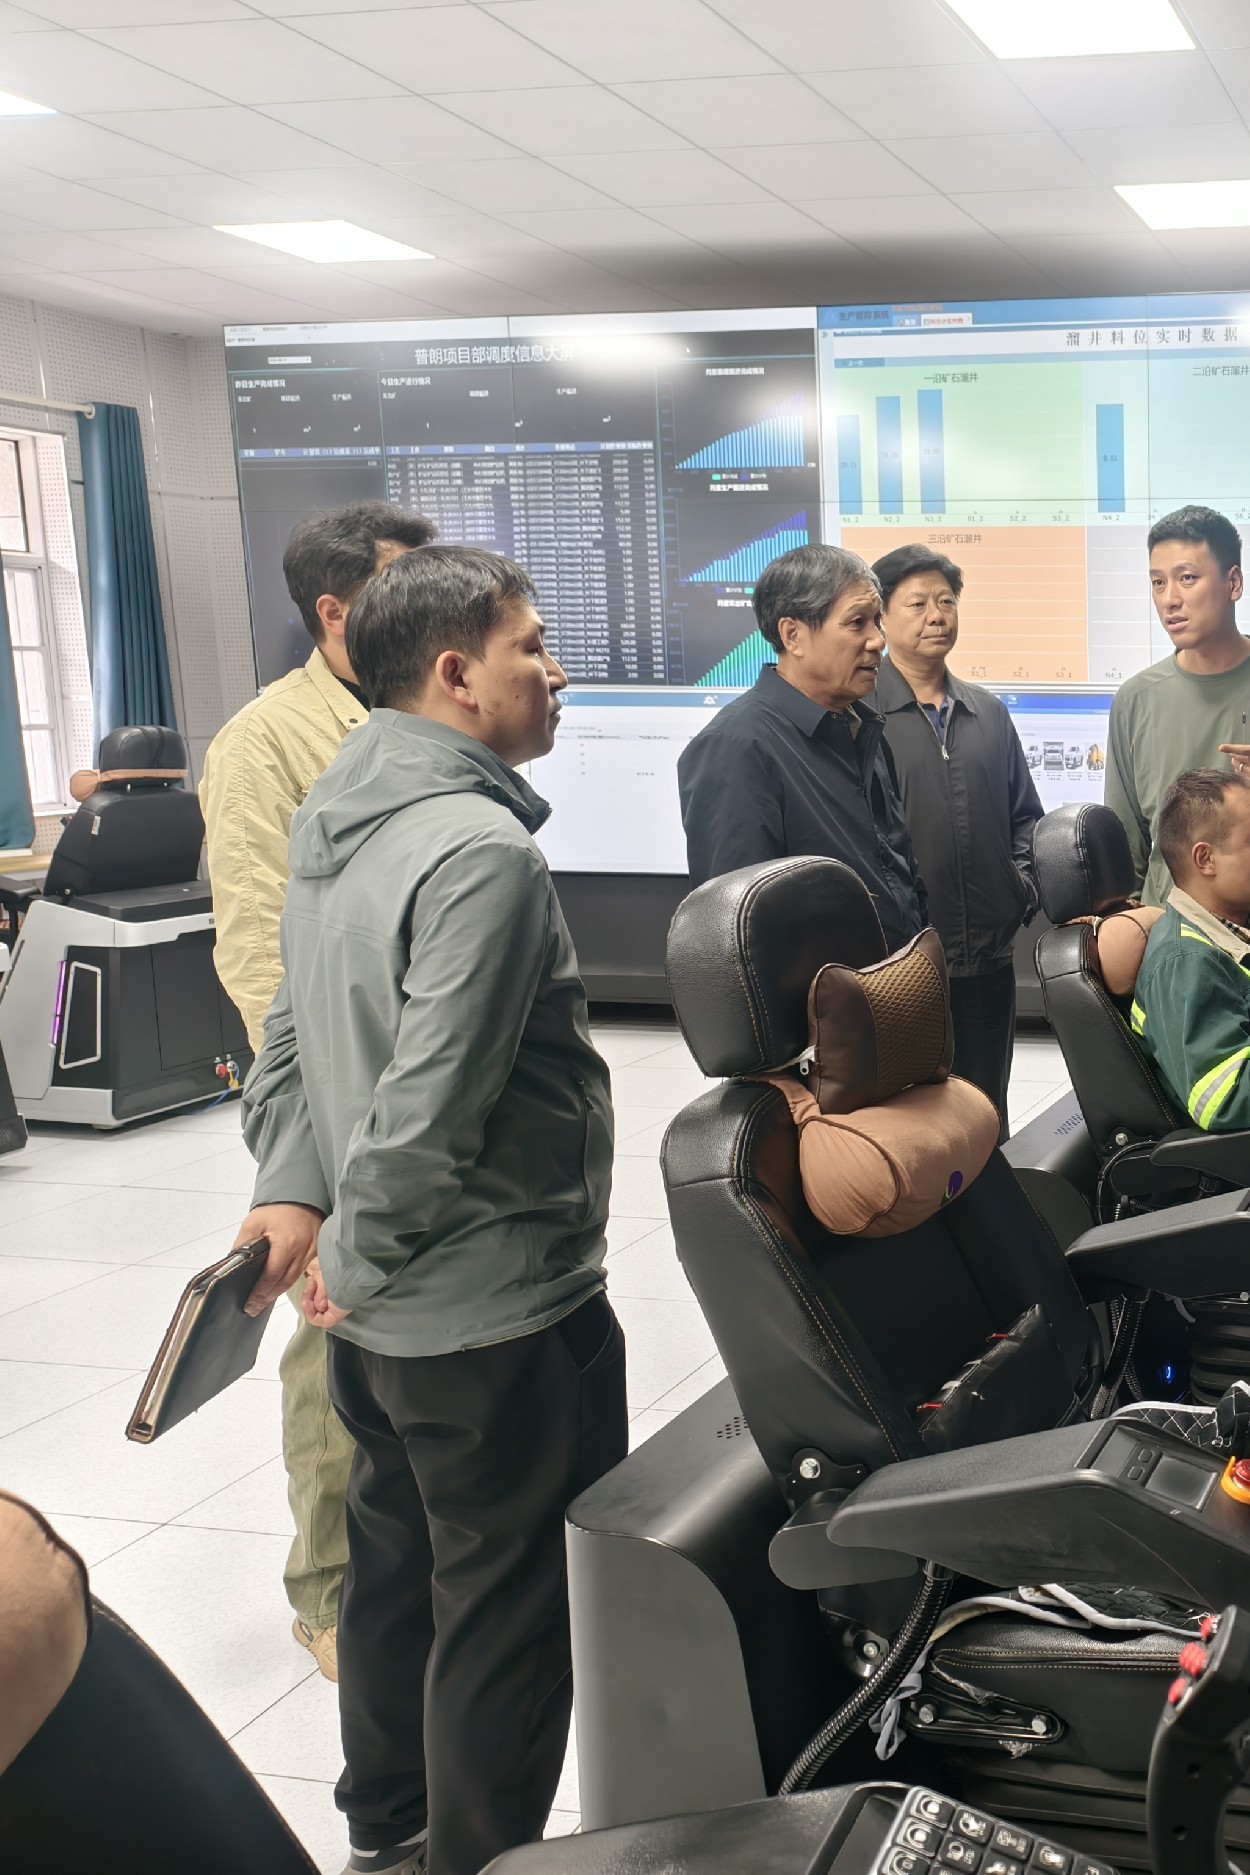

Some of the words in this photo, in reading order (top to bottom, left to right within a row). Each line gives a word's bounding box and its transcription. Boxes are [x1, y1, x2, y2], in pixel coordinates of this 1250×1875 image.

[1066, 326, 1239, 347] 溜井料位实时数据
[414, 344, 576, 365] 普朗项目部调度信息大屏
[1192, 365, 1250, 377] 二沿矿石溜井
[924, 373, 979, 385] 一沿矿石溜井
[928, 533, 983, 545] 三沿矿石溜井
